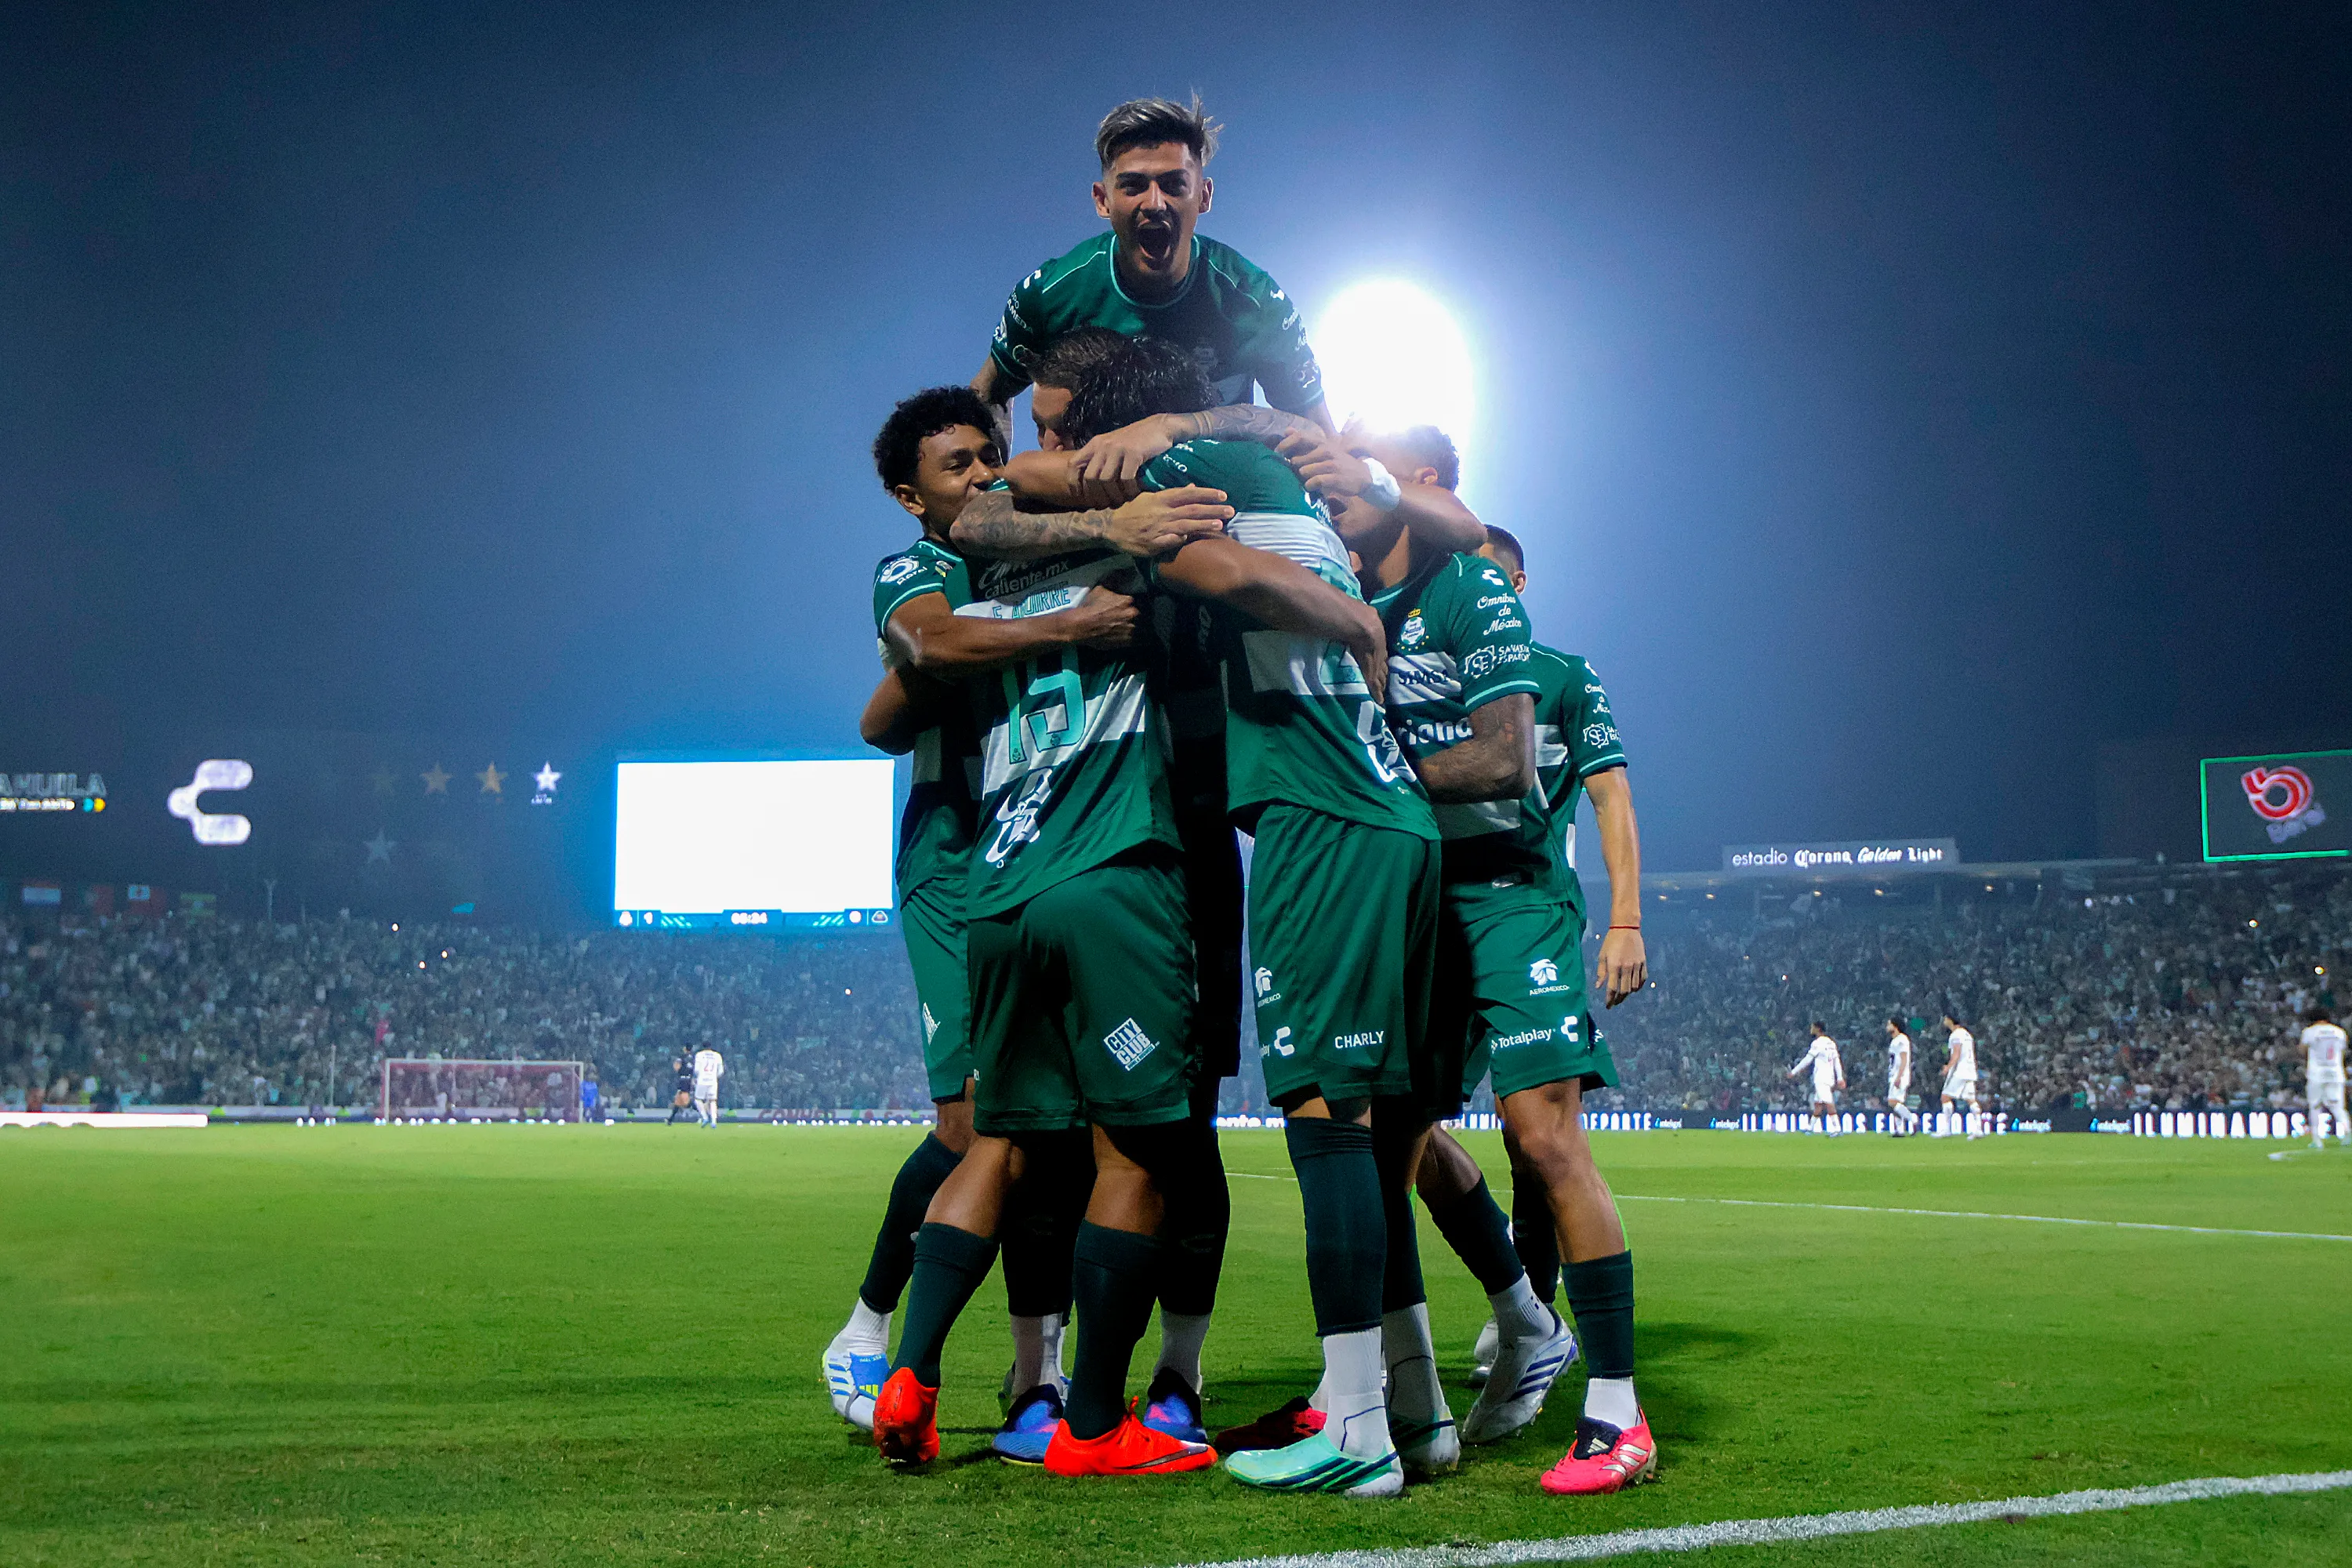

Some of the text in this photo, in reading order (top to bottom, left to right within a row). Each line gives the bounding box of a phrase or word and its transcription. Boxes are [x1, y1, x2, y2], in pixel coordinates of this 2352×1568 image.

[1011, 582, 1071, 619] AUIRRE
[1498, 604, 1512, 616] de
[1399, 717, 1473, 745] riana
[1733, 847, 1944, 869] estadio Corona Golden Light
[1530, 985, 1569, 996] AEROMEXICO
[1107, 1020, 1139, 1051] CITY
[1334, 1030, 1385, 1049] CHARLY
[1498, 1029, 1552, 1048] Totalplay
[1116, 1033, 1151, 1065] CLUB
[2133, 1112, 2307, 1138] ILUMINAMOS
